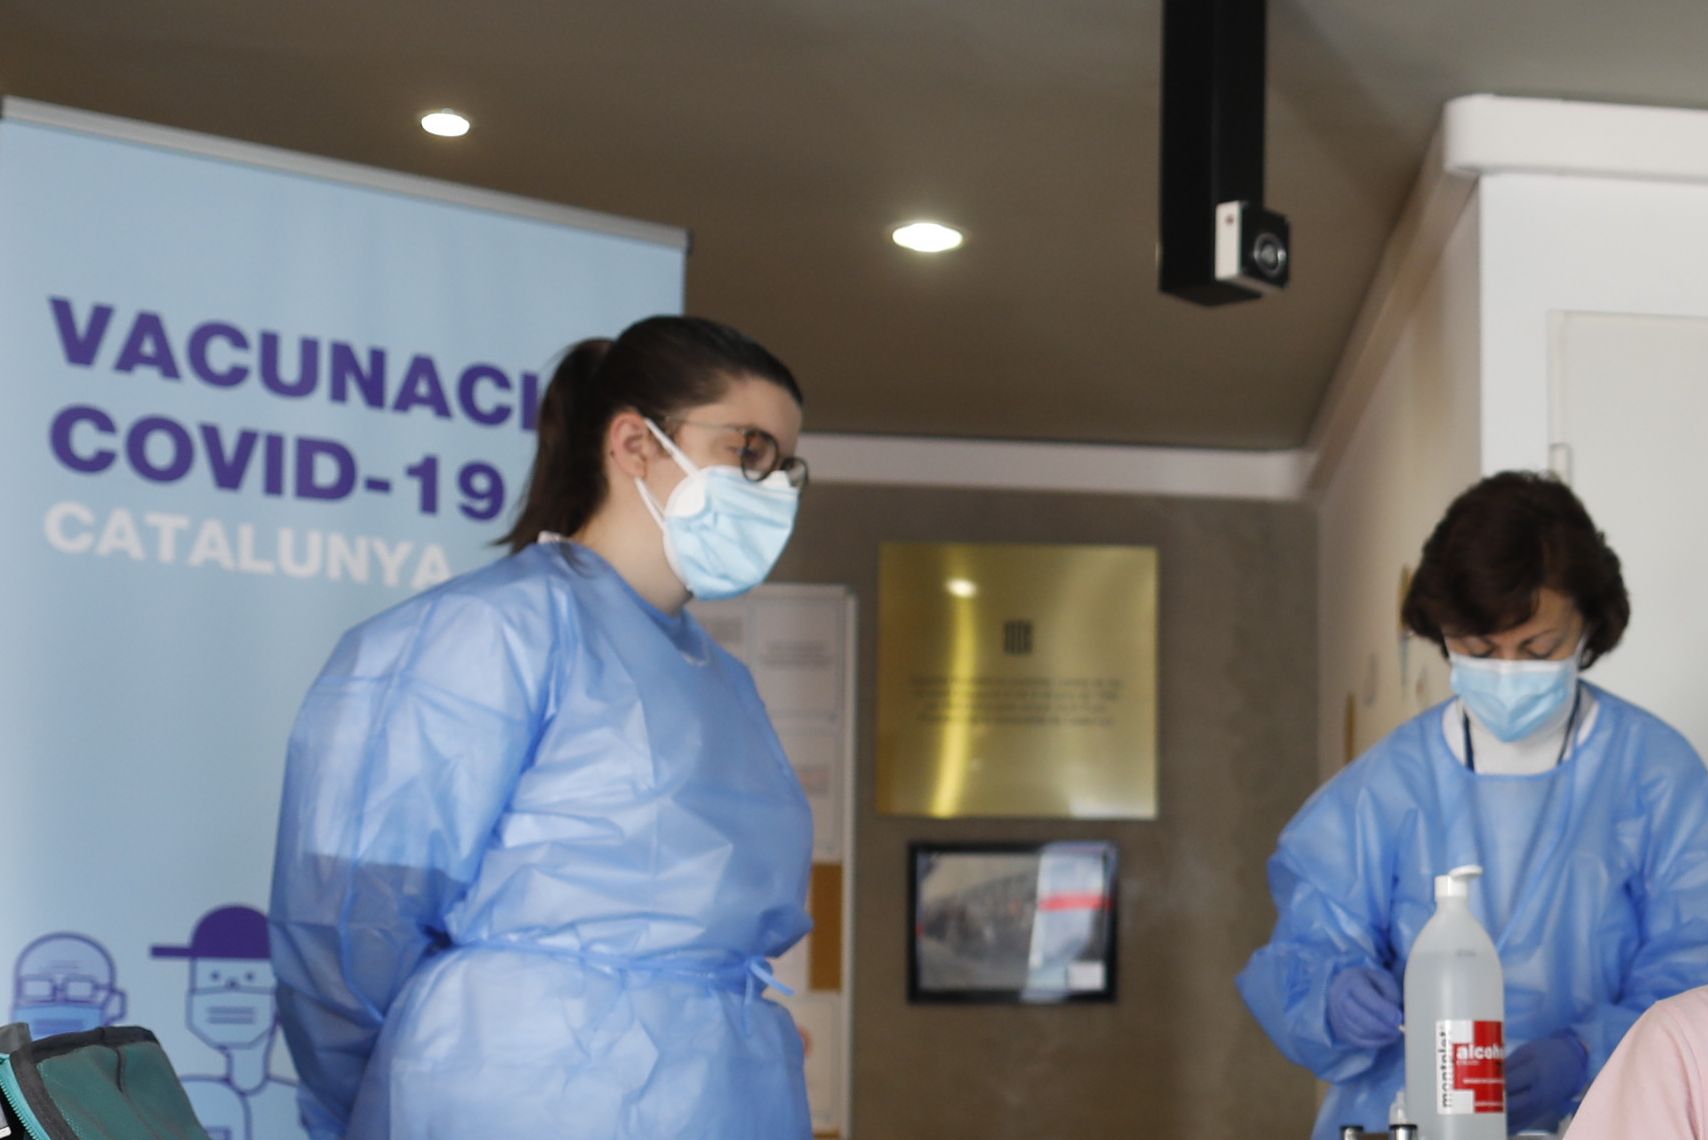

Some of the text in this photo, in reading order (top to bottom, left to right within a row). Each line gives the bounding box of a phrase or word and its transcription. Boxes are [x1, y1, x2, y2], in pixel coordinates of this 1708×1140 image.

[48, 296, 541, 433] VACUNACI
[49, 404, 506, 522] COVID-19
[44, 502, 452, 591] CATALUNYA
